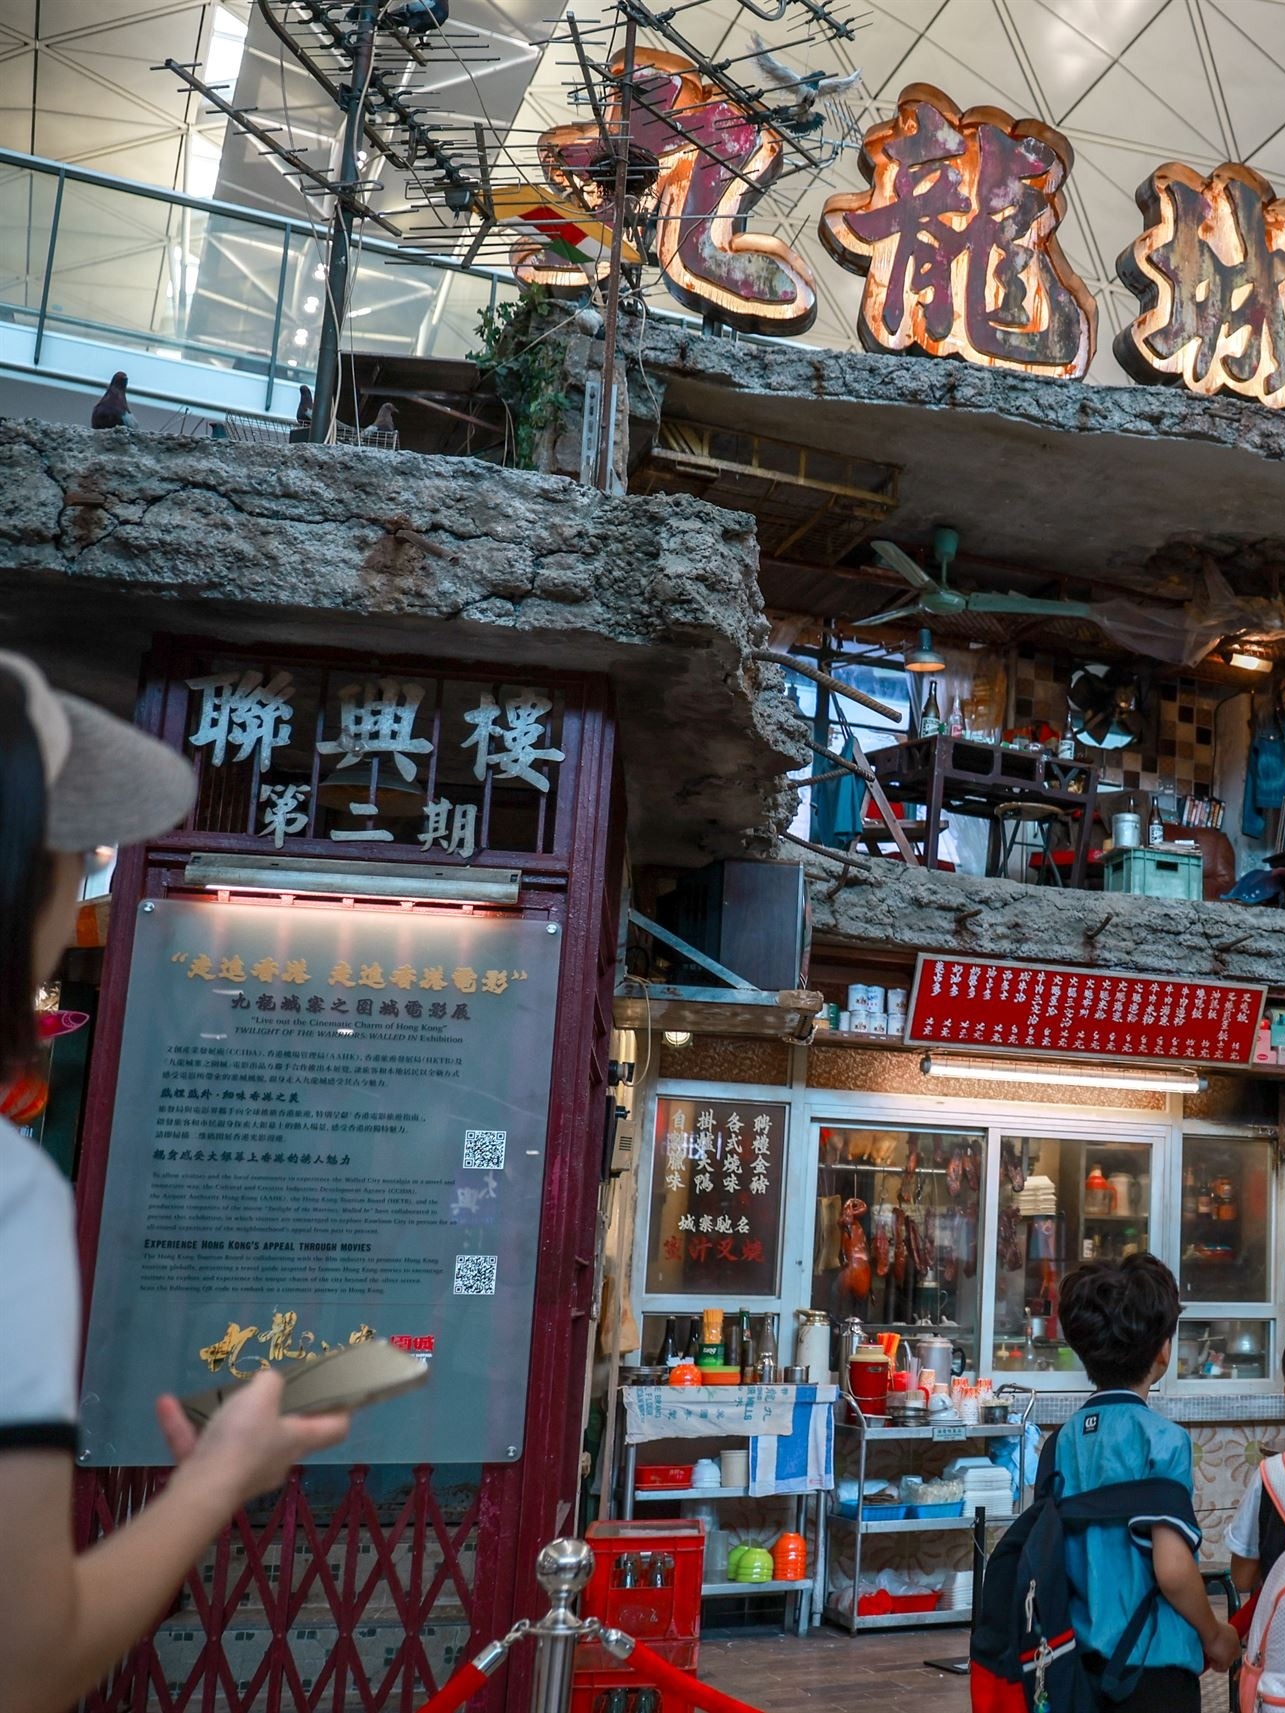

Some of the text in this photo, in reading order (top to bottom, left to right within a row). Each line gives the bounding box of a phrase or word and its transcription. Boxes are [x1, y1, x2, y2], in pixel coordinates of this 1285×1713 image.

[258, 783, 478, 858] 第二期
[234, 1026, 280, 1035] TWILIGHT
[282, 1028, 294, 1036] OF
[297, 1029, 314, 1037] THE
[369, 1033, 405, 1041] WALLED
[420, 1035, 463, 1043] Exhibition
[293, 1018, 306, 1026] the
[310, 1018, 352, 1028] Cinematic
[354, 1020, 382, 1029] Charm
[396, 1022, 419, 1032] Hong
[722, 1111, 745, 1194] 各式燒味
[678, 1213, 750, 1235] 城寨馳名
[144, 1239, 198, 1249] EXPERIENCE
[201, 1240, 224, 1250] HONG
[262, 1242, 295, 1251] APPEAL
[299, 1242, 337, 1252] THROUGH
[341, 1243, 372, 1252] MOVIES
